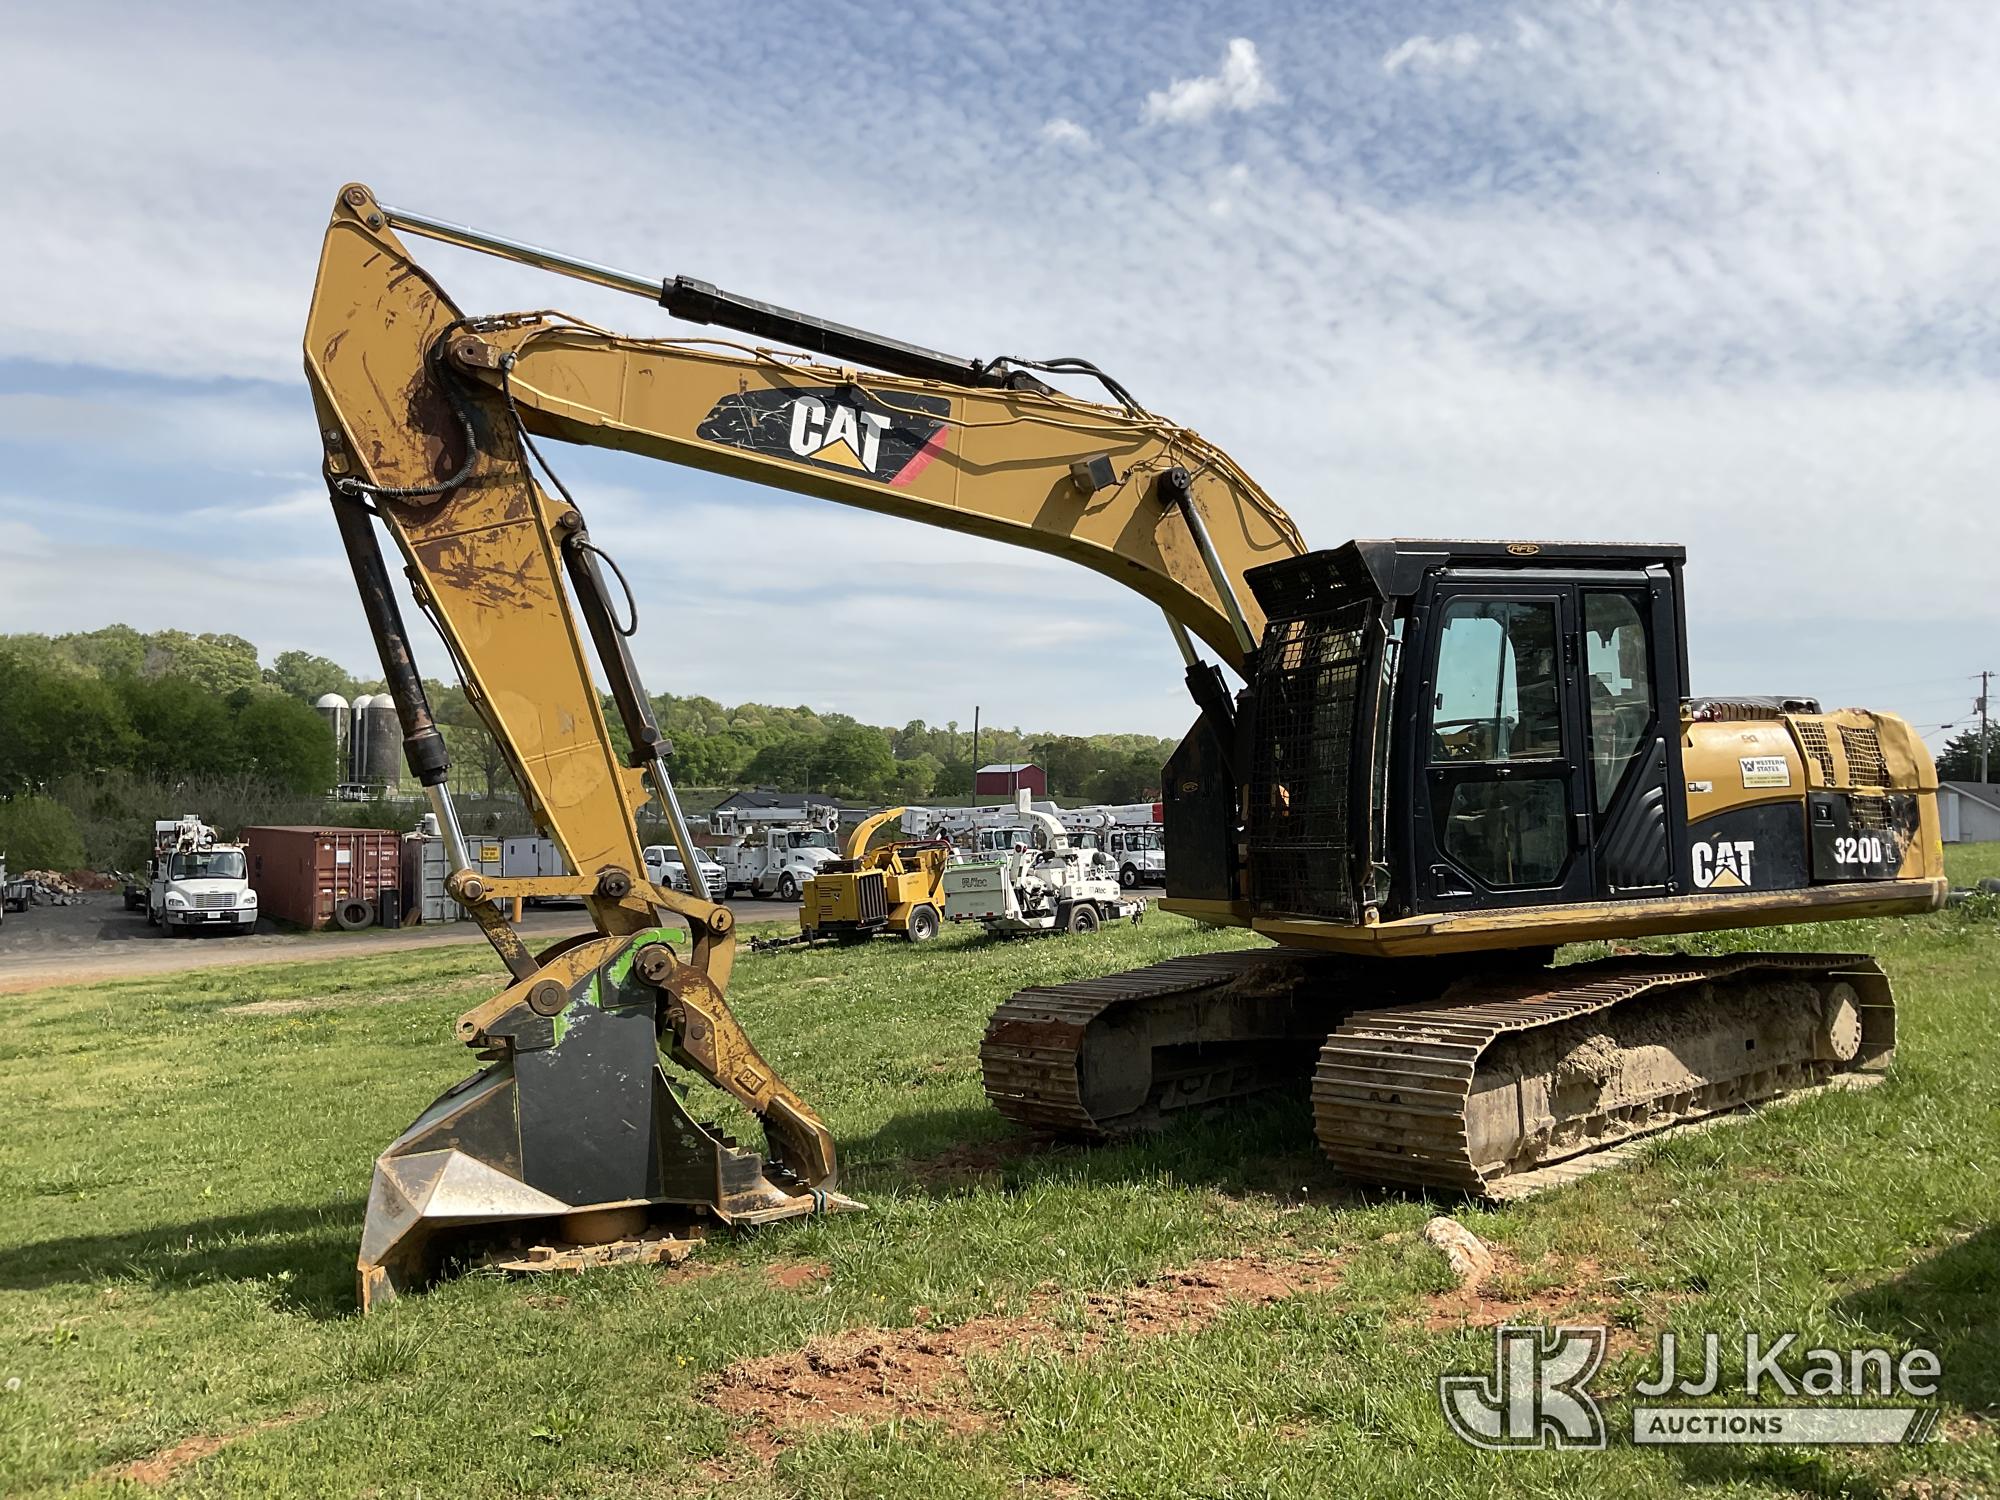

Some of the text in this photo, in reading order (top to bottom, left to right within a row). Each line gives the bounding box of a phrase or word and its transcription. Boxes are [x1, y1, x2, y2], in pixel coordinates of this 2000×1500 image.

[790, 395, 891, 473] CAT
[1691, 841, 1754, 888] CAT
[1833, 837, 1897, 864] 320D L
[740, 1068, 764, 1091] CAT
